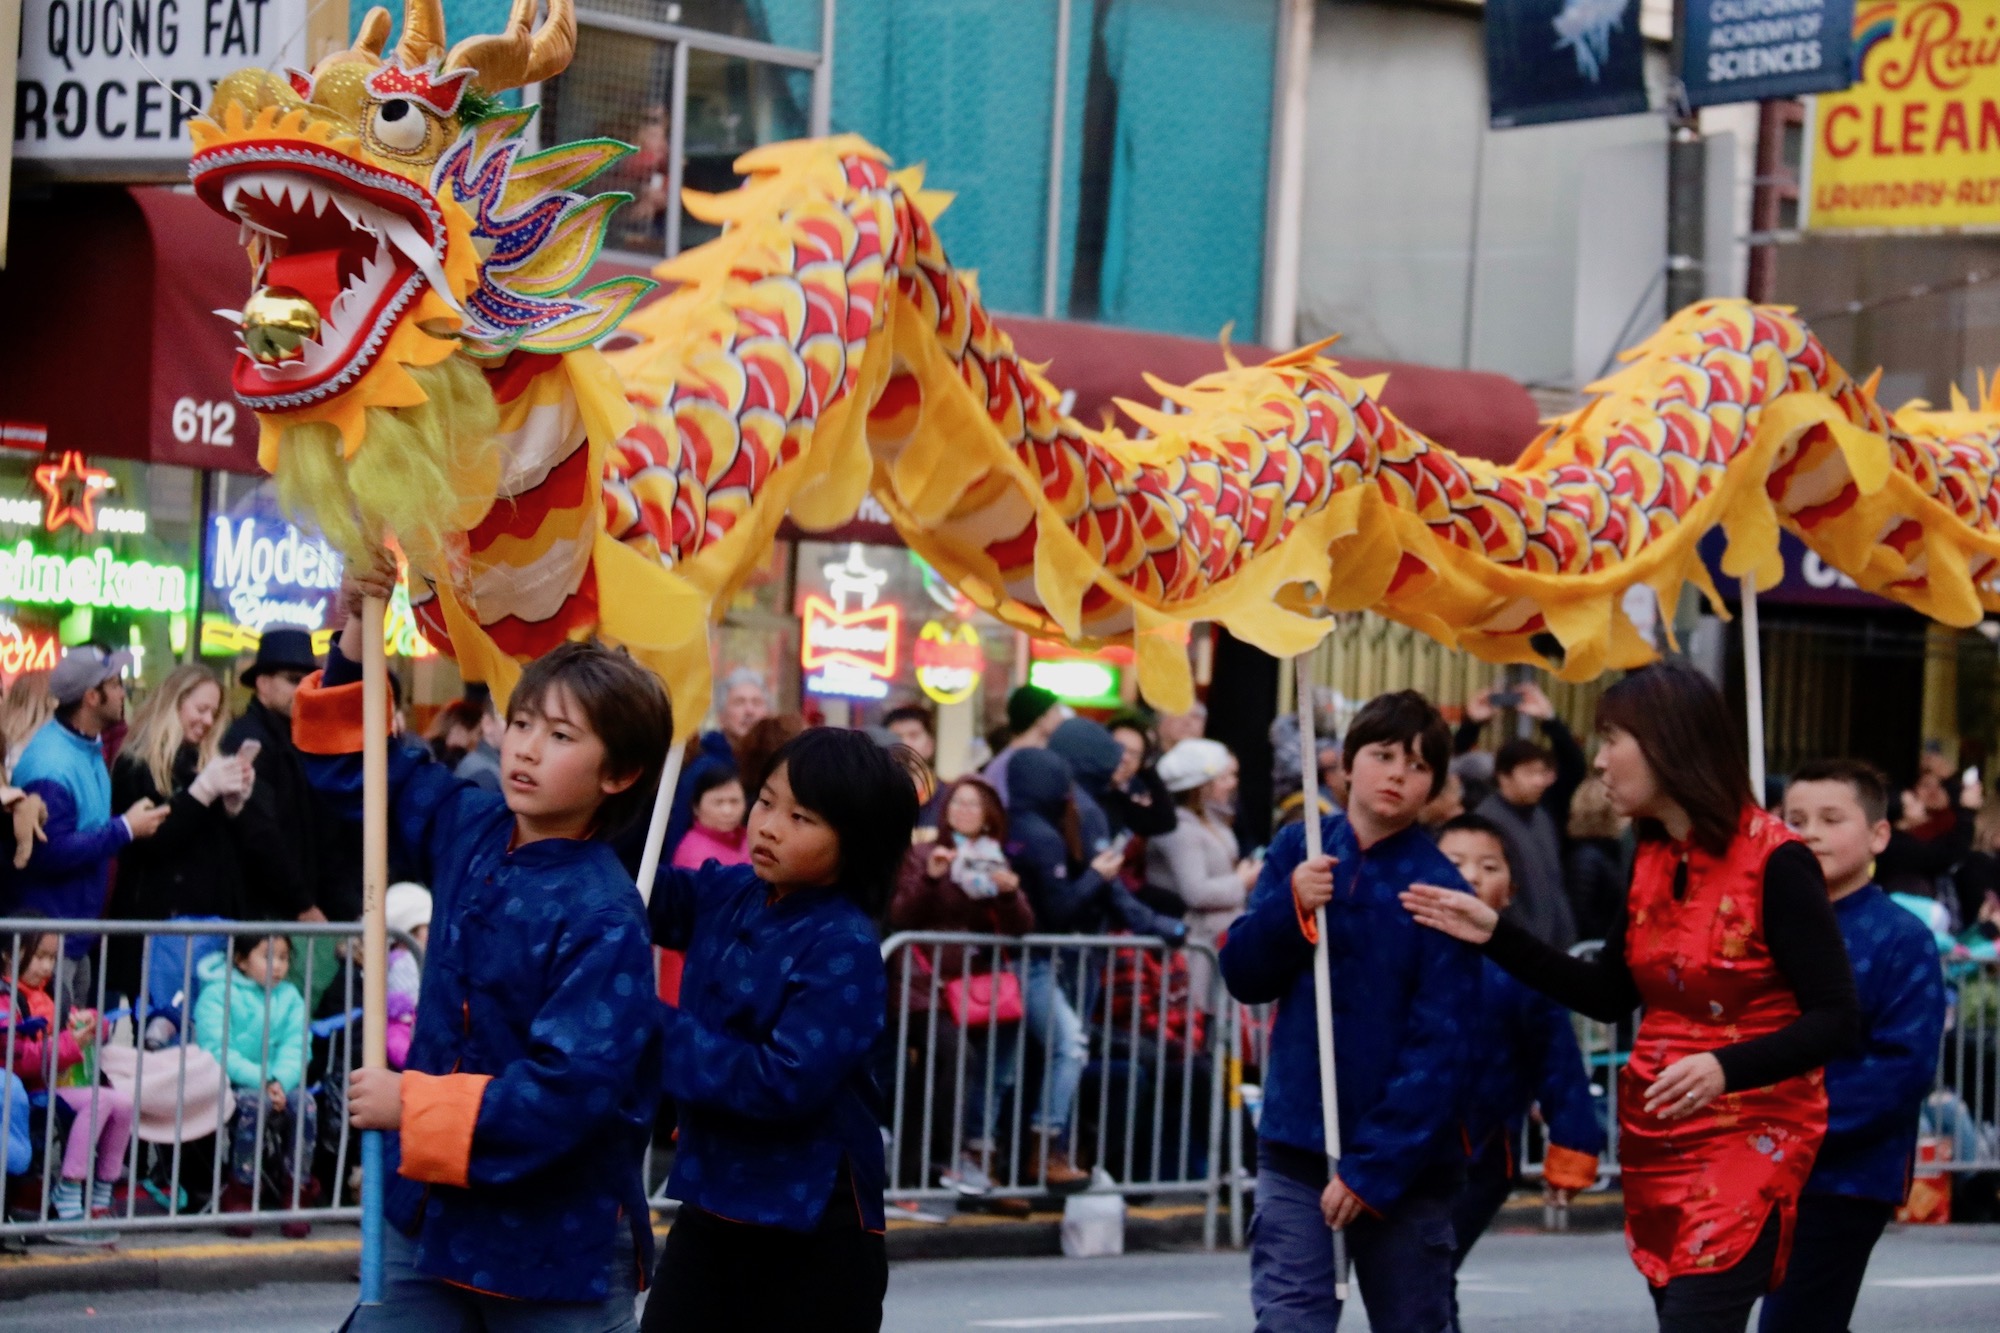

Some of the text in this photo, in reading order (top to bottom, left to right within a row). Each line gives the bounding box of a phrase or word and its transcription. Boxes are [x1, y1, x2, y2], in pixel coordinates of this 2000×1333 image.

[48, 0, 179, 71] QUONG
[204, 0, 269, 56] FAT
[1707, 40, 1822, 82] SCIENCES
[1709, 19, 1795, 48] ACADEMY
[1878, 1, 2000, 91] Rai
[14, 79, 219, 140] ROCER
[172, 396, 236, 447] 612
